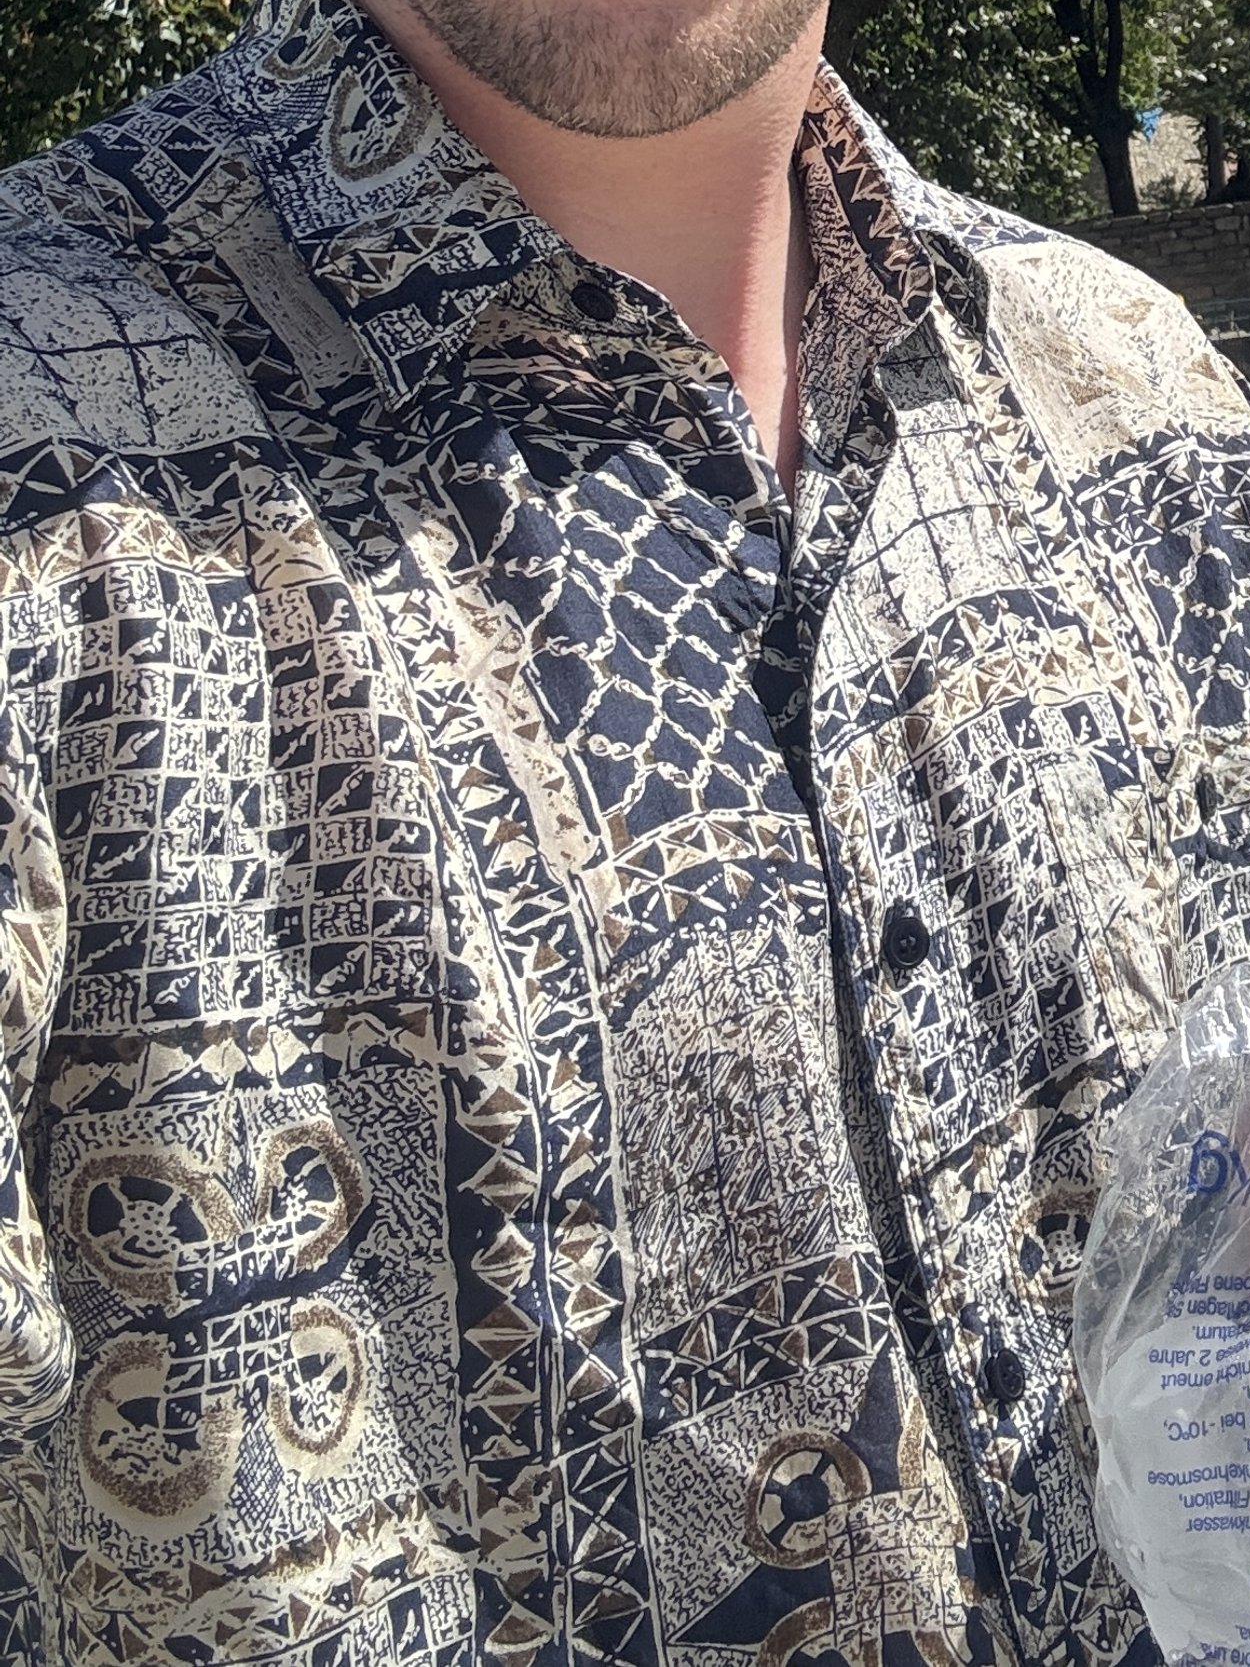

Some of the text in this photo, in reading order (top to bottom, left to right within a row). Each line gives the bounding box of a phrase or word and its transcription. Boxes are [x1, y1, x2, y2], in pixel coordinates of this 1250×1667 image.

[1149, 1349, 1195, 1368] Jahre
[1199, 1349, 1211, 1366] 2
[1221, 1411, 1245, 1433] bei
[1179, 1490, 1250, 1510] Filtration,
